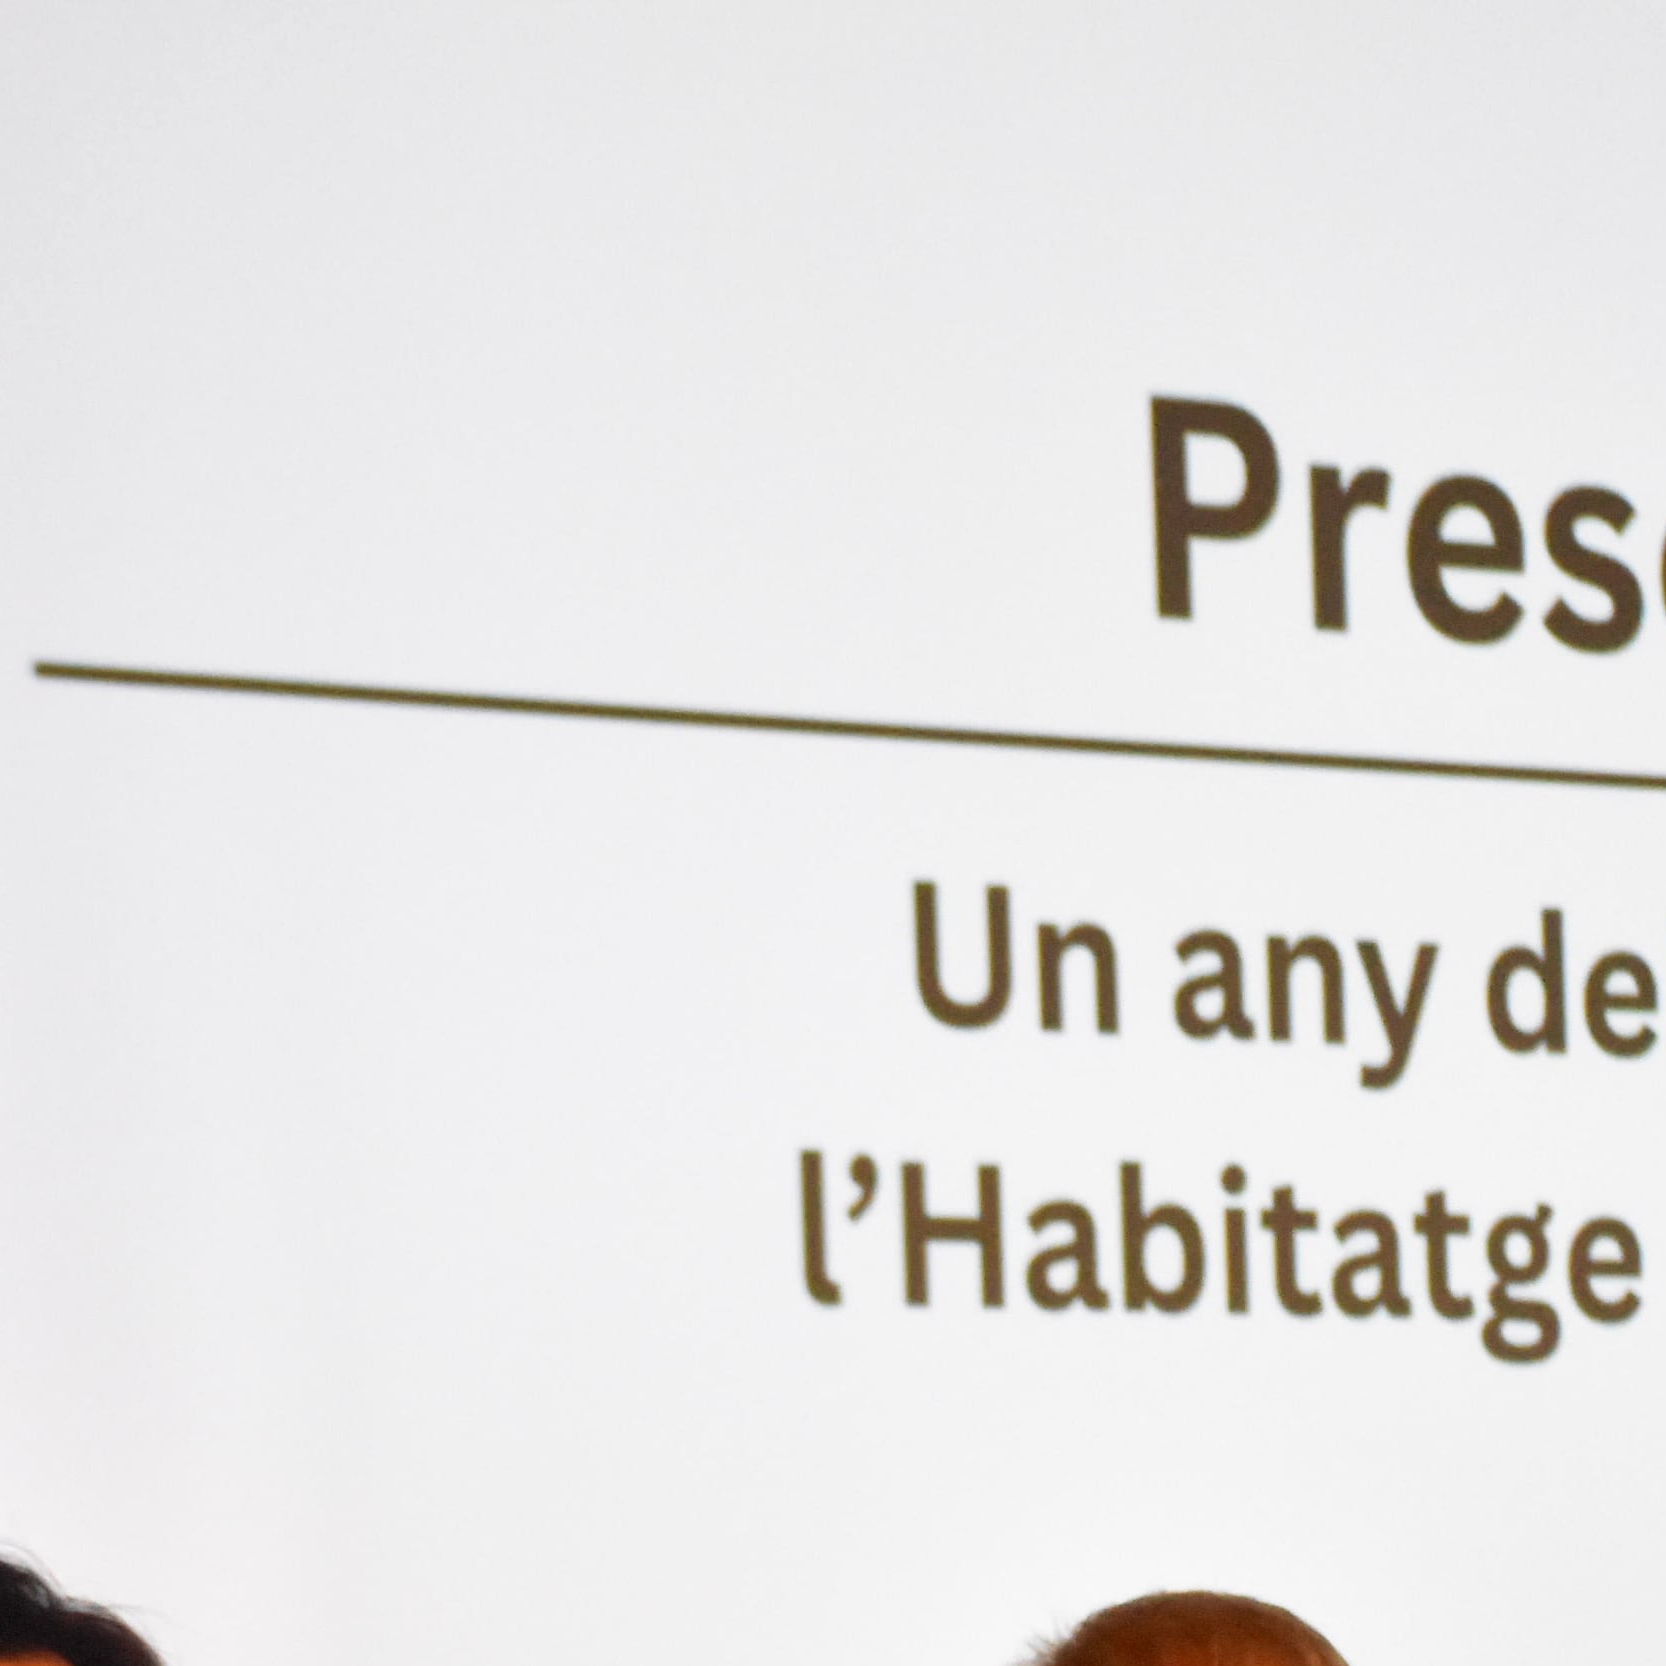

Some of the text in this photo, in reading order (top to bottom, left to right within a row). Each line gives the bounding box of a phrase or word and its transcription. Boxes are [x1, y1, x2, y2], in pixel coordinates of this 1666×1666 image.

[914, 883, 1118, 1034] Un
[1174, 931, 1438, 1089] any
[801, 1150, 1642, 1363] l’Habitatge
